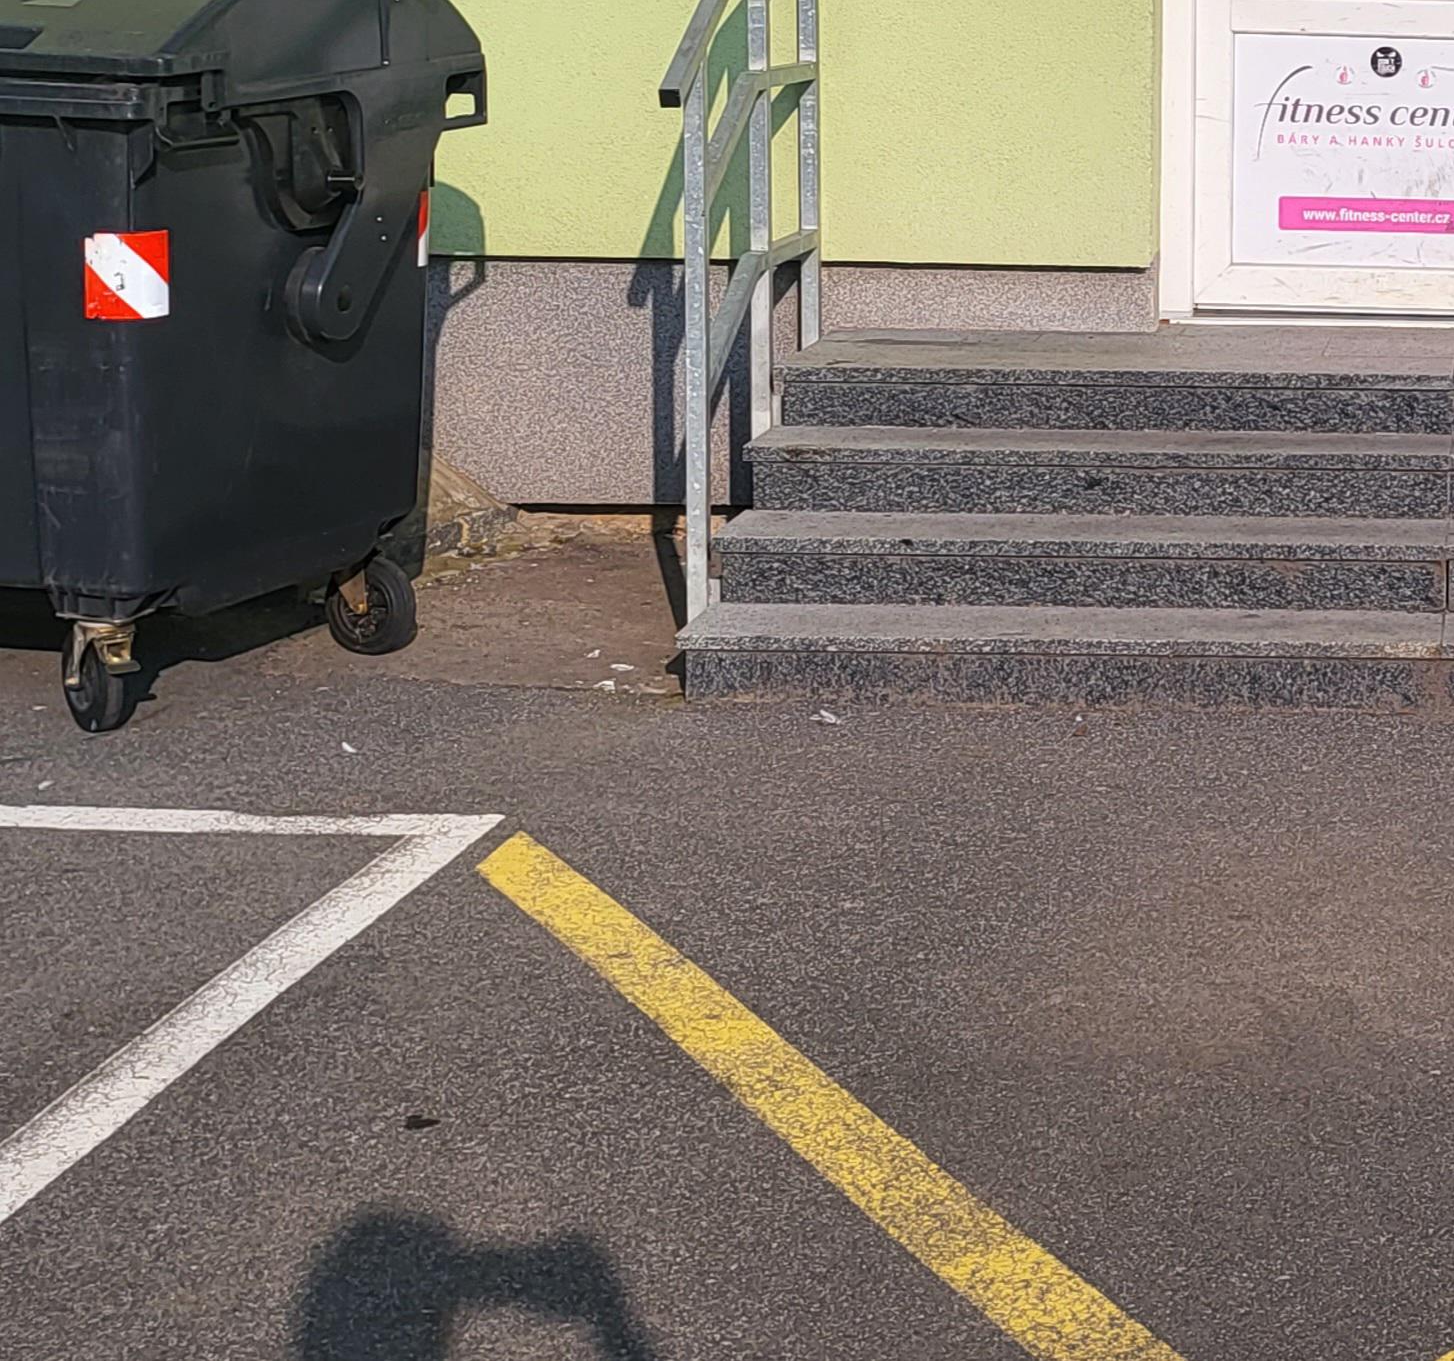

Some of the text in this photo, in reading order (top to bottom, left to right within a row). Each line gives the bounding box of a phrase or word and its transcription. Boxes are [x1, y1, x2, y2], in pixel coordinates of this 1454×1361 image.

[1253, 65, 1381, 160] fitness
[1277, 132, 1320, 145] BÁRY
[1348, 136, 1405, 147] HANKY
[1302, 207, 1451, 225] www.fitness-center.cz
